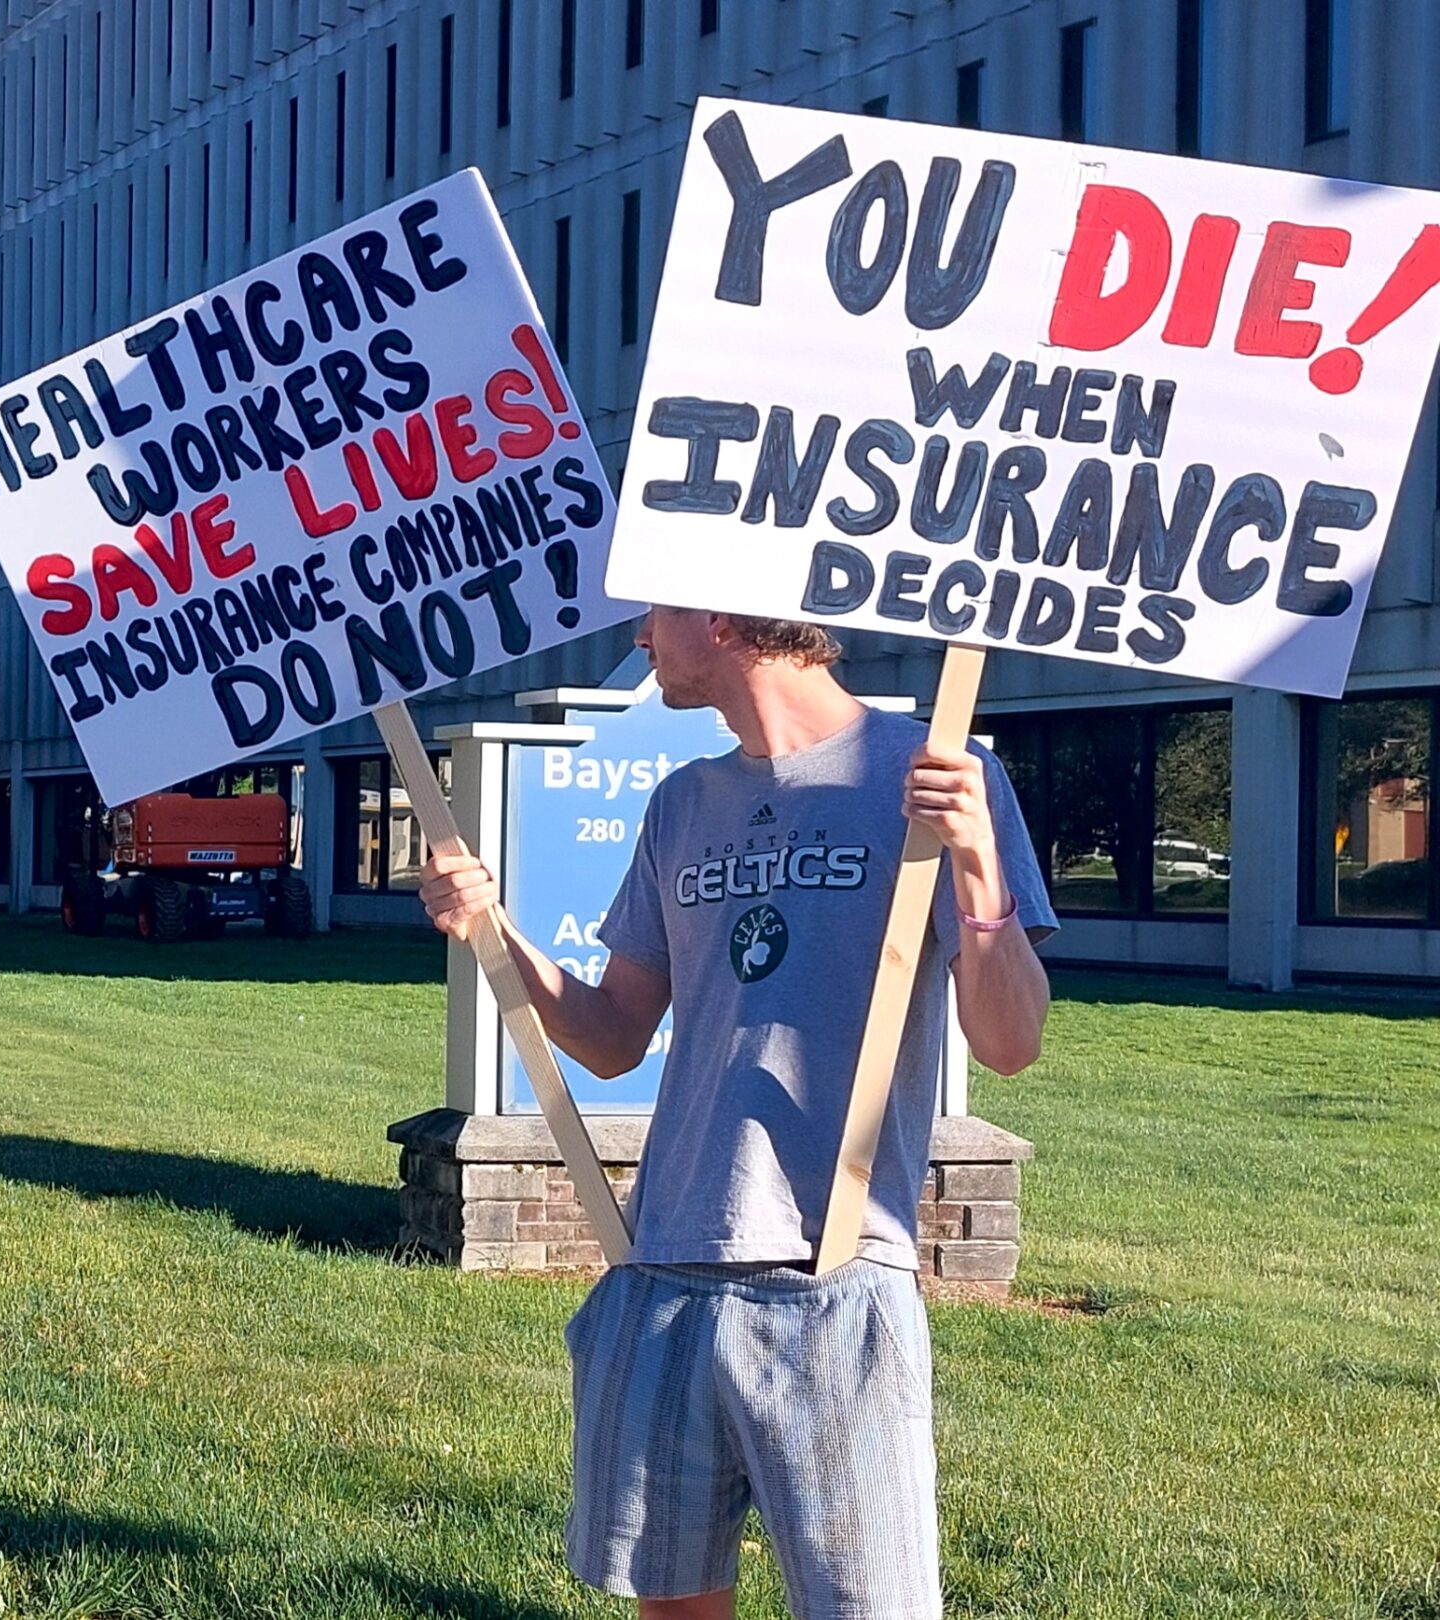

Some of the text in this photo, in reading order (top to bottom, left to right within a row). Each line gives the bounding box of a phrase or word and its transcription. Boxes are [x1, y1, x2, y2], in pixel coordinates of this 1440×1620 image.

[703, 109, 1440, 395] YOU DIE!
[87, 329, 430, 526] WORKERS
[906, 346, 1176, 458] WHEN
[26, 324, 581, 635] SAVE LIVES!
[642, 397, 1377, 617] INSURANCE
[50, 457, 604, 723] INSURANCE COMPANIES
[801, 541, 1196, 663] DECIDES
[212, 639, 335, 749] DO
[543, 747, 712, 800] Bayst
[576, 817, 625, 842] 280
[675, 845, 869, 908] CELTICS
[704, 830, 827, 857] BOSTON
